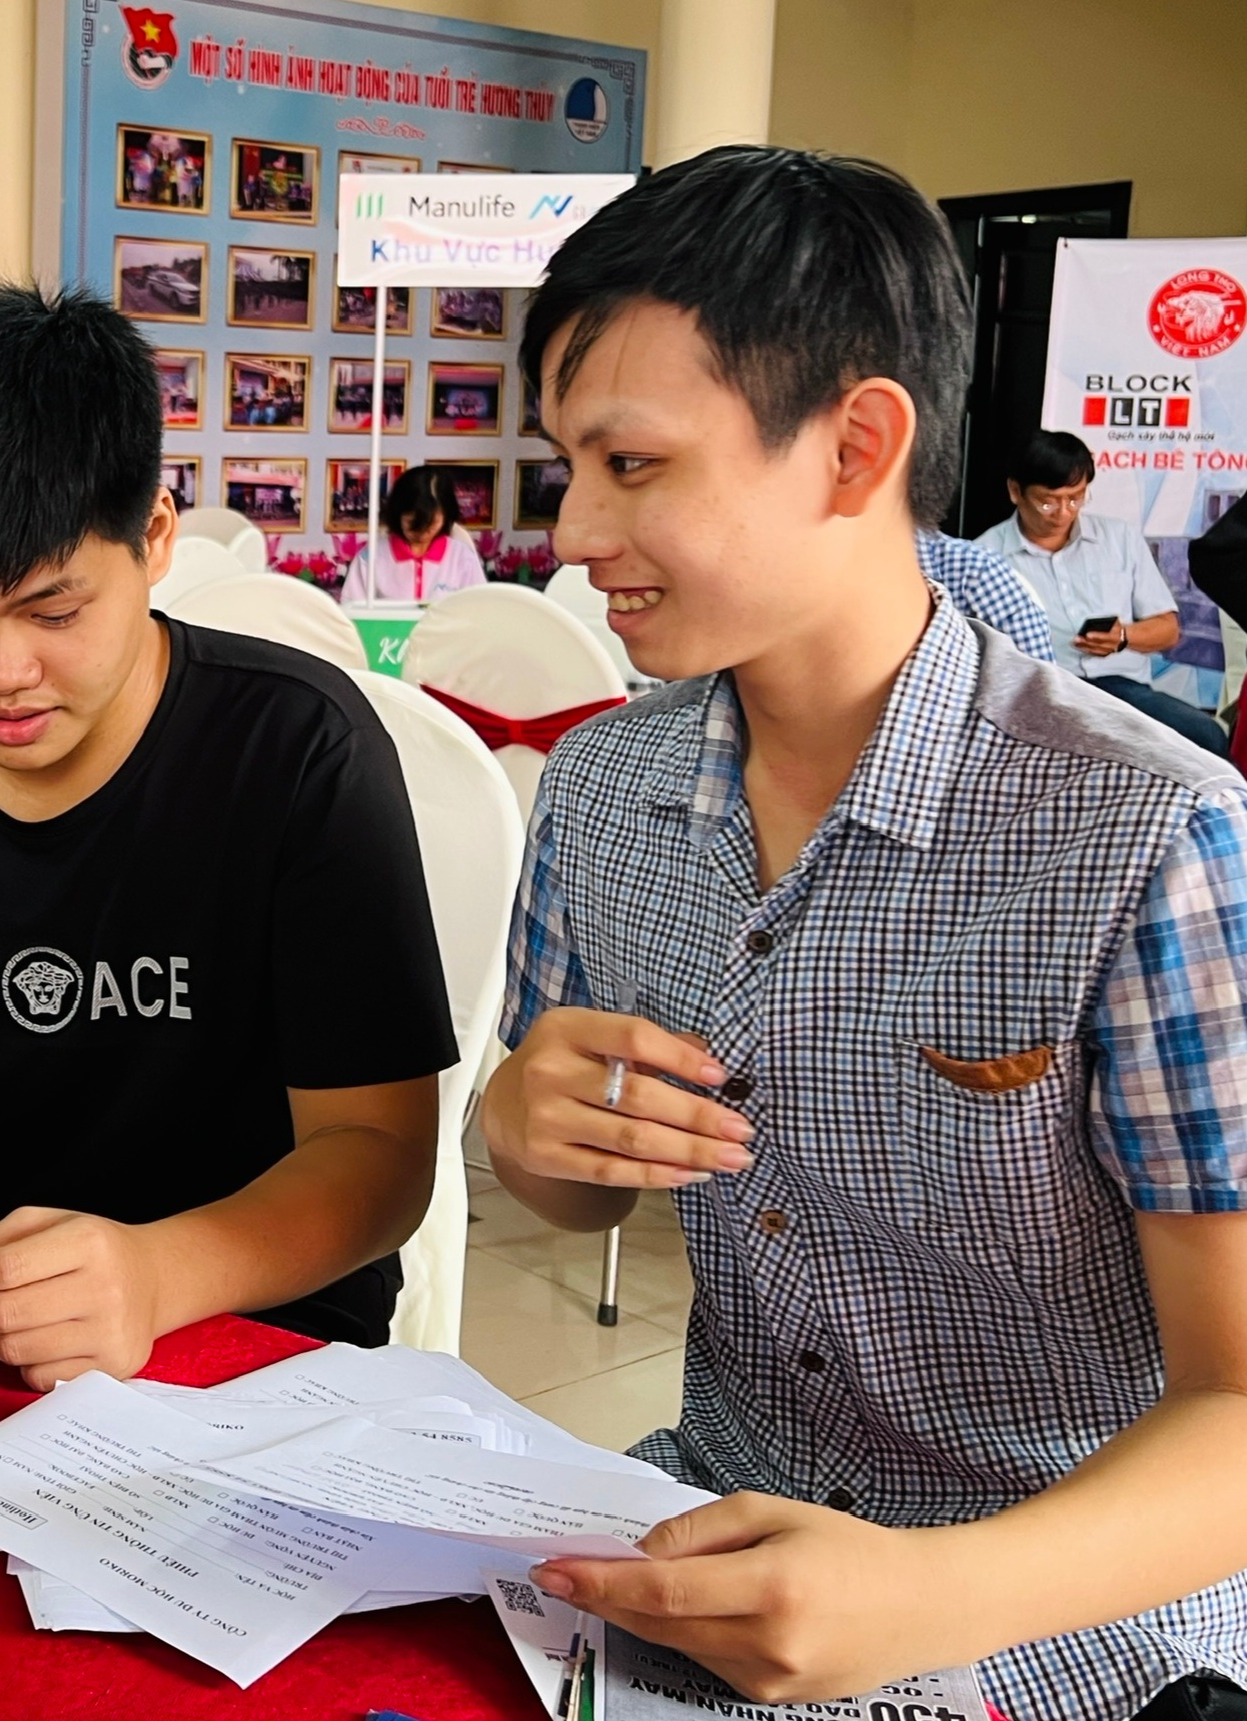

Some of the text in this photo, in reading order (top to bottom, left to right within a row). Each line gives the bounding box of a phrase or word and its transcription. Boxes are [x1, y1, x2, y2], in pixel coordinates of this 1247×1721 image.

[409, 195, 515, 218] Manulife
[371, 239, 432, 262] Khu
[514, 240, 554, 261] Hu
[1198, 337, 1232, 358] NAM
[1086, 374, 1193, 393] BLOCK
[1113, 399, 1160, 426] LT
[1092, 451, 1147, 472] ẠCH
[90, 957, 192, 1021] ACE
[93, 1518, 112, 1530] TIN
[115, 1530, 156, 1555] THÔNG
[161, 1556, 198, 1577] PHIẾU
[99, 1558, 246, 1636] CÔNG TY DU HỌC MORIKO
[626, 1675, 688, 1703] MAY
